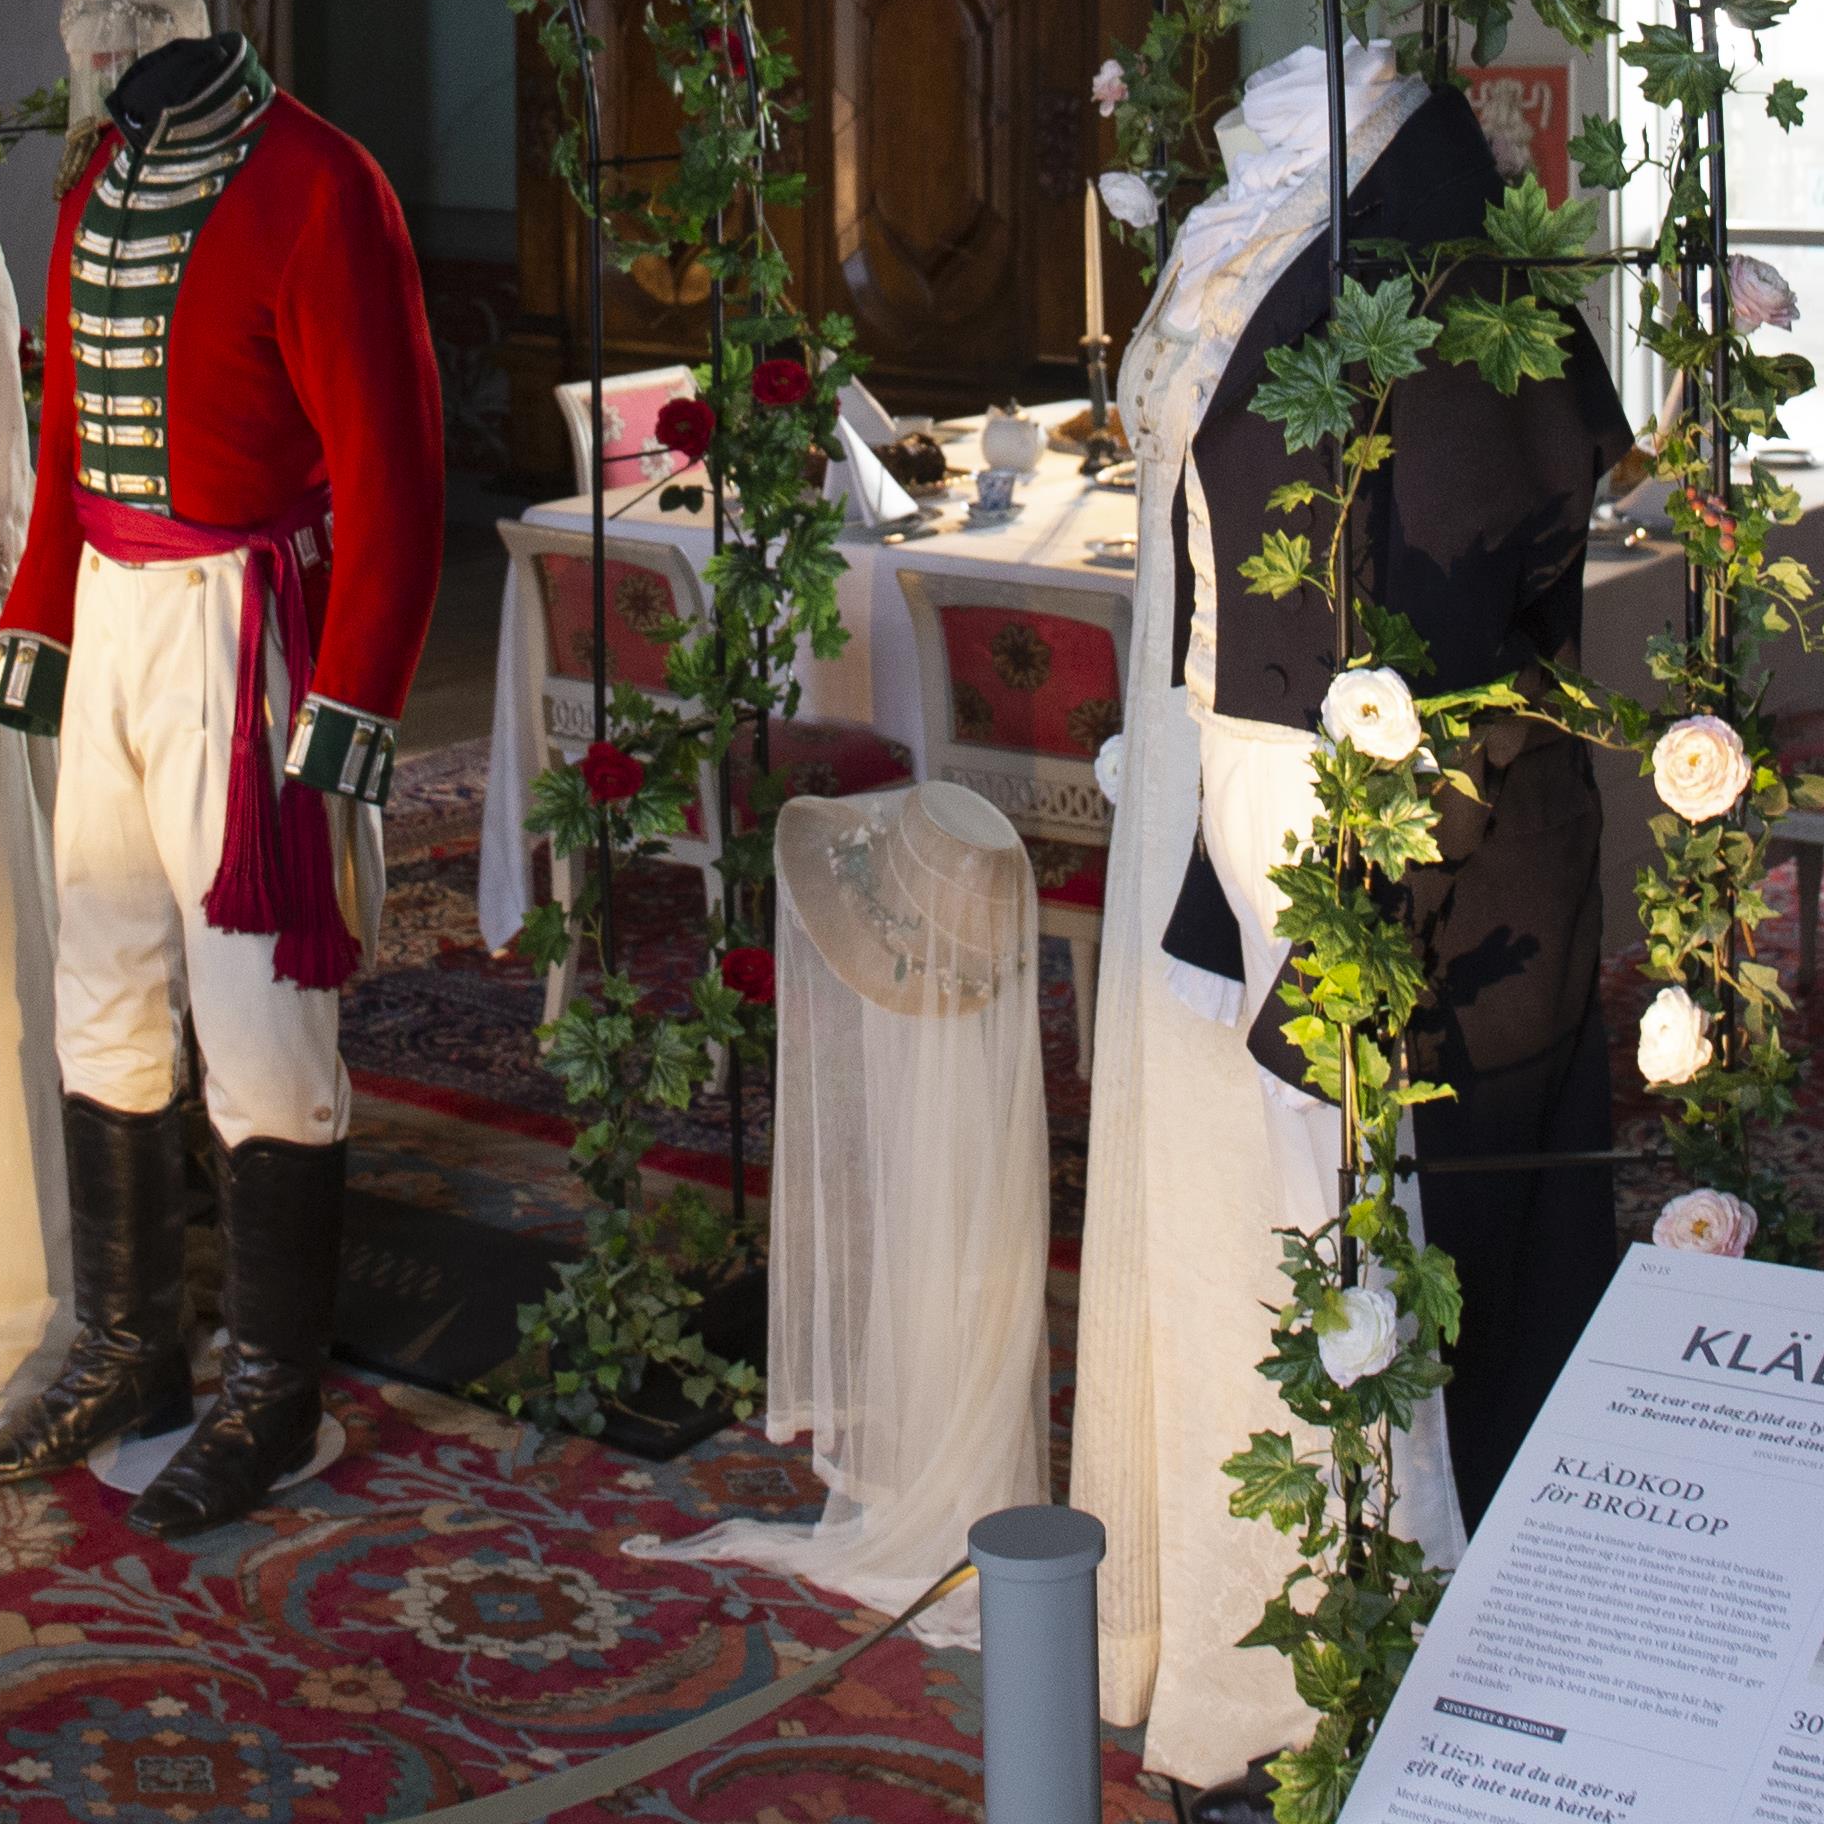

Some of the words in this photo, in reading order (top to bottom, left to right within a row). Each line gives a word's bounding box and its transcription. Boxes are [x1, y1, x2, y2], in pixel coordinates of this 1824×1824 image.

[1553, 1456, 1704, 1501] KLÄDKOD
[1530, 1482, 1579, 1504] för
[1583, 1491, 1729, 1536] BRÖLLOP
[1790, 1711, 1824, 1734] 30
[1404, 1759, 1438, 1777] gift
[1440, 1767, 1470, 1787] dig
[1471, 1774, 1506, 1795] inte
[1509, 1788, 1551, 1808] utan
[1554, 1796, 1626, 1824] kärlek"
[1421, 1734, 1438, 1753] "Å
[1440, 1742, 1485, 1767] Lizzy,
[1492, 1759, 1526, 1776] vad
[1527, 1766, 1551, 1783] du
[1554, 1775, 1578, 1790] än
[1578, 1783, 1613, 1799] gör
[1614, 1791, 1637, 1806] så
